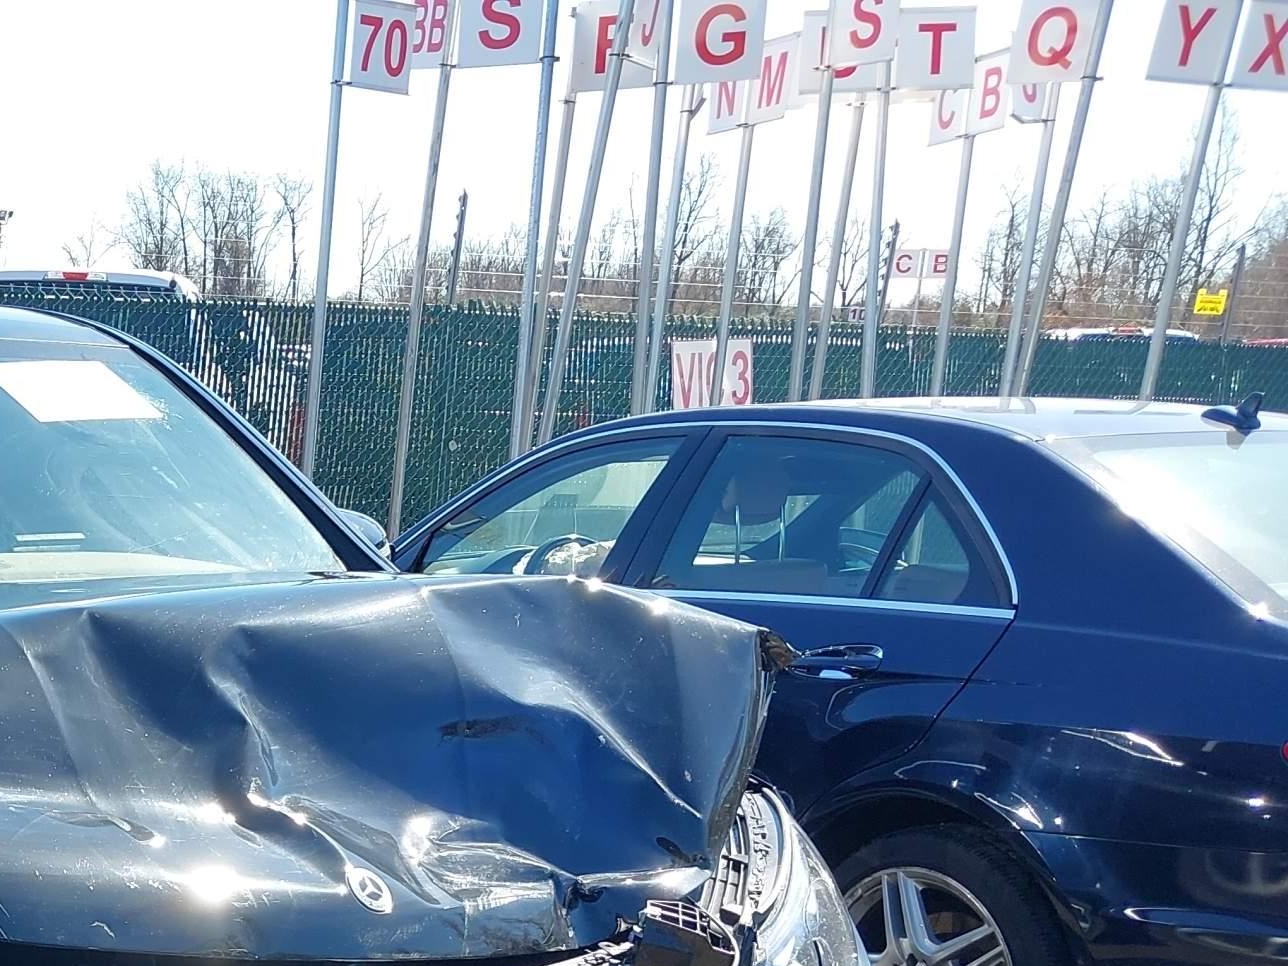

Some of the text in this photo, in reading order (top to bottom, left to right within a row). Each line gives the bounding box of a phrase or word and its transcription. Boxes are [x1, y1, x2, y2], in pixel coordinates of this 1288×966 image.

[360, 14, 408, 78] 70
[478, 0, 521, 50] S
[695, 3, 746, 66] G
[849, 0, 883, 49] S
[918, 23, 957, 75] T
[1027, 6, 1078, 70] Q
[1177, 4, 1217, 67] Y
[1248, 13, 1288, 76] X
[757, 51, 788, 109] M
[979, 66, 1003, 120] B
[896, 254, 913, 273] C
[933, 254, 949, 273] B
